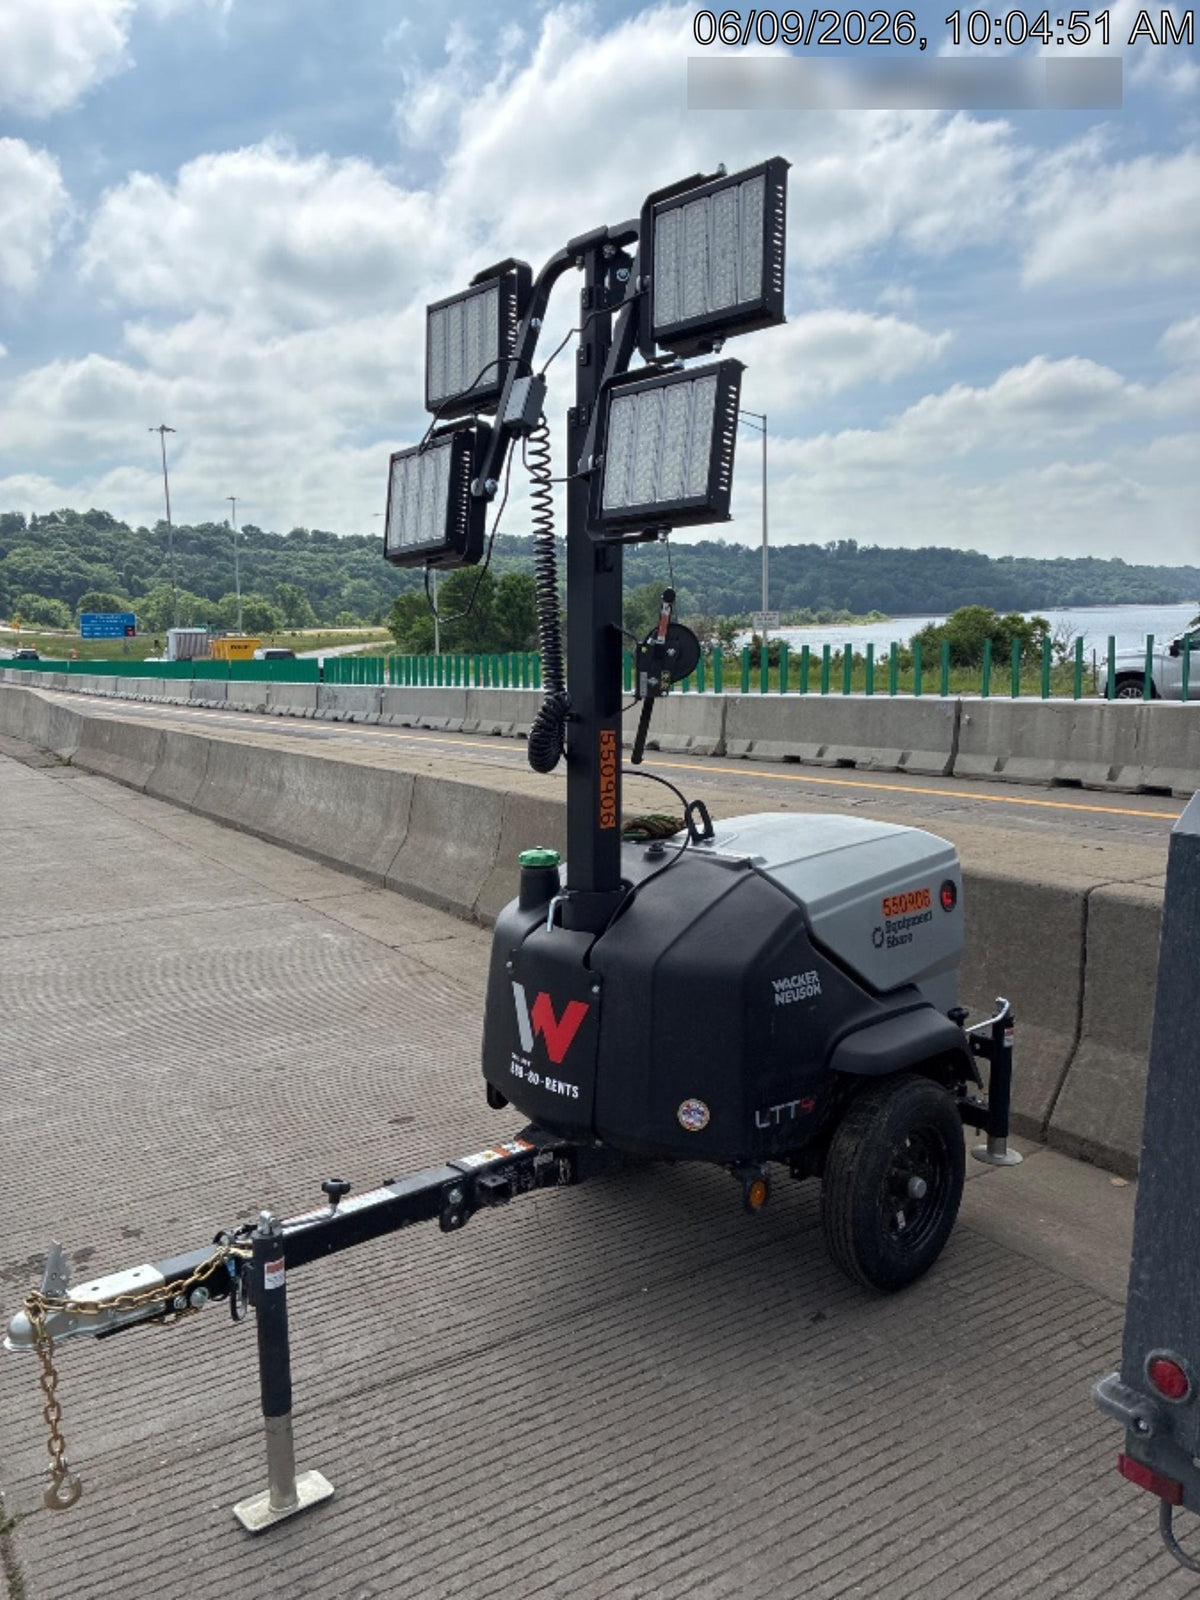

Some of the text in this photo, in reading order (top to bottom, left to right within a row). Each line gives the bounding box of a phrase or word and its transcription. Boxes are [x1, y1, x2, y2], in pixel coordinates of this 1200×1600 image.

[600, 732, 615, 826] 550906
[882, 888, 931, 917] 550906
[771, 970, 820, 992] WACKER
[774, 982, 822, 1005] NEUSON
